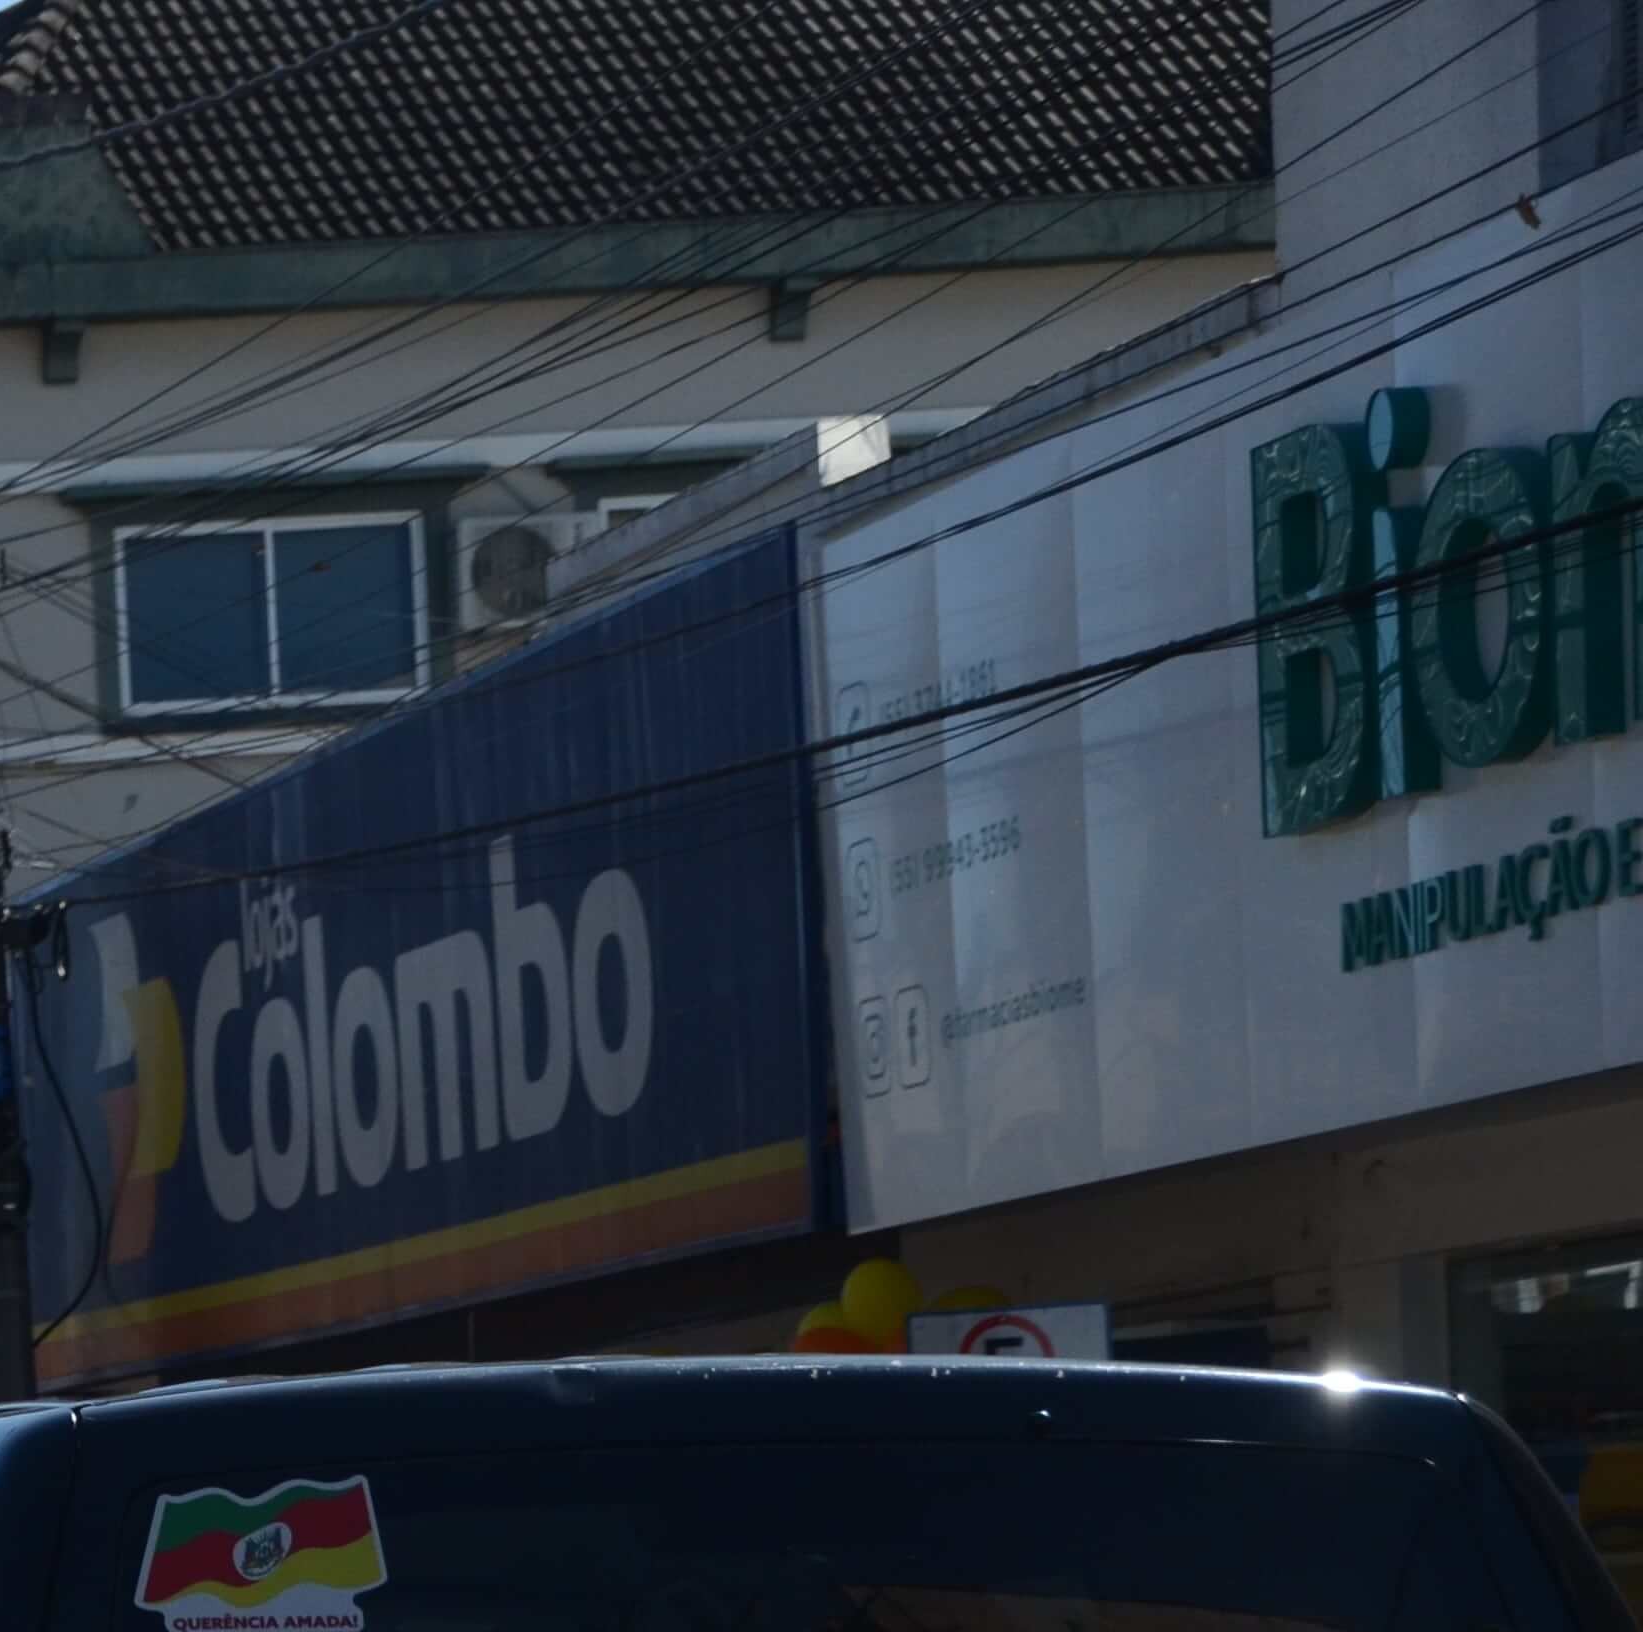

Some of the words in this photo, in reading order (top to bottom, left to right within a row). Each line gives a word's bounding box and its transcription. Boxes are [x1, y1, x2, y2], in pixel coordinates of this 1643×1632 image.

[239, 878, 301, 990] lojas
[1339, 816, 1612, 973] MANIPULAÇÃO
[194, 834, 655, 1223] Colombo
[173, 1612, 279, 1632] QUERÊNCIA
[284, 1612, 359, 1631] AMADA!
